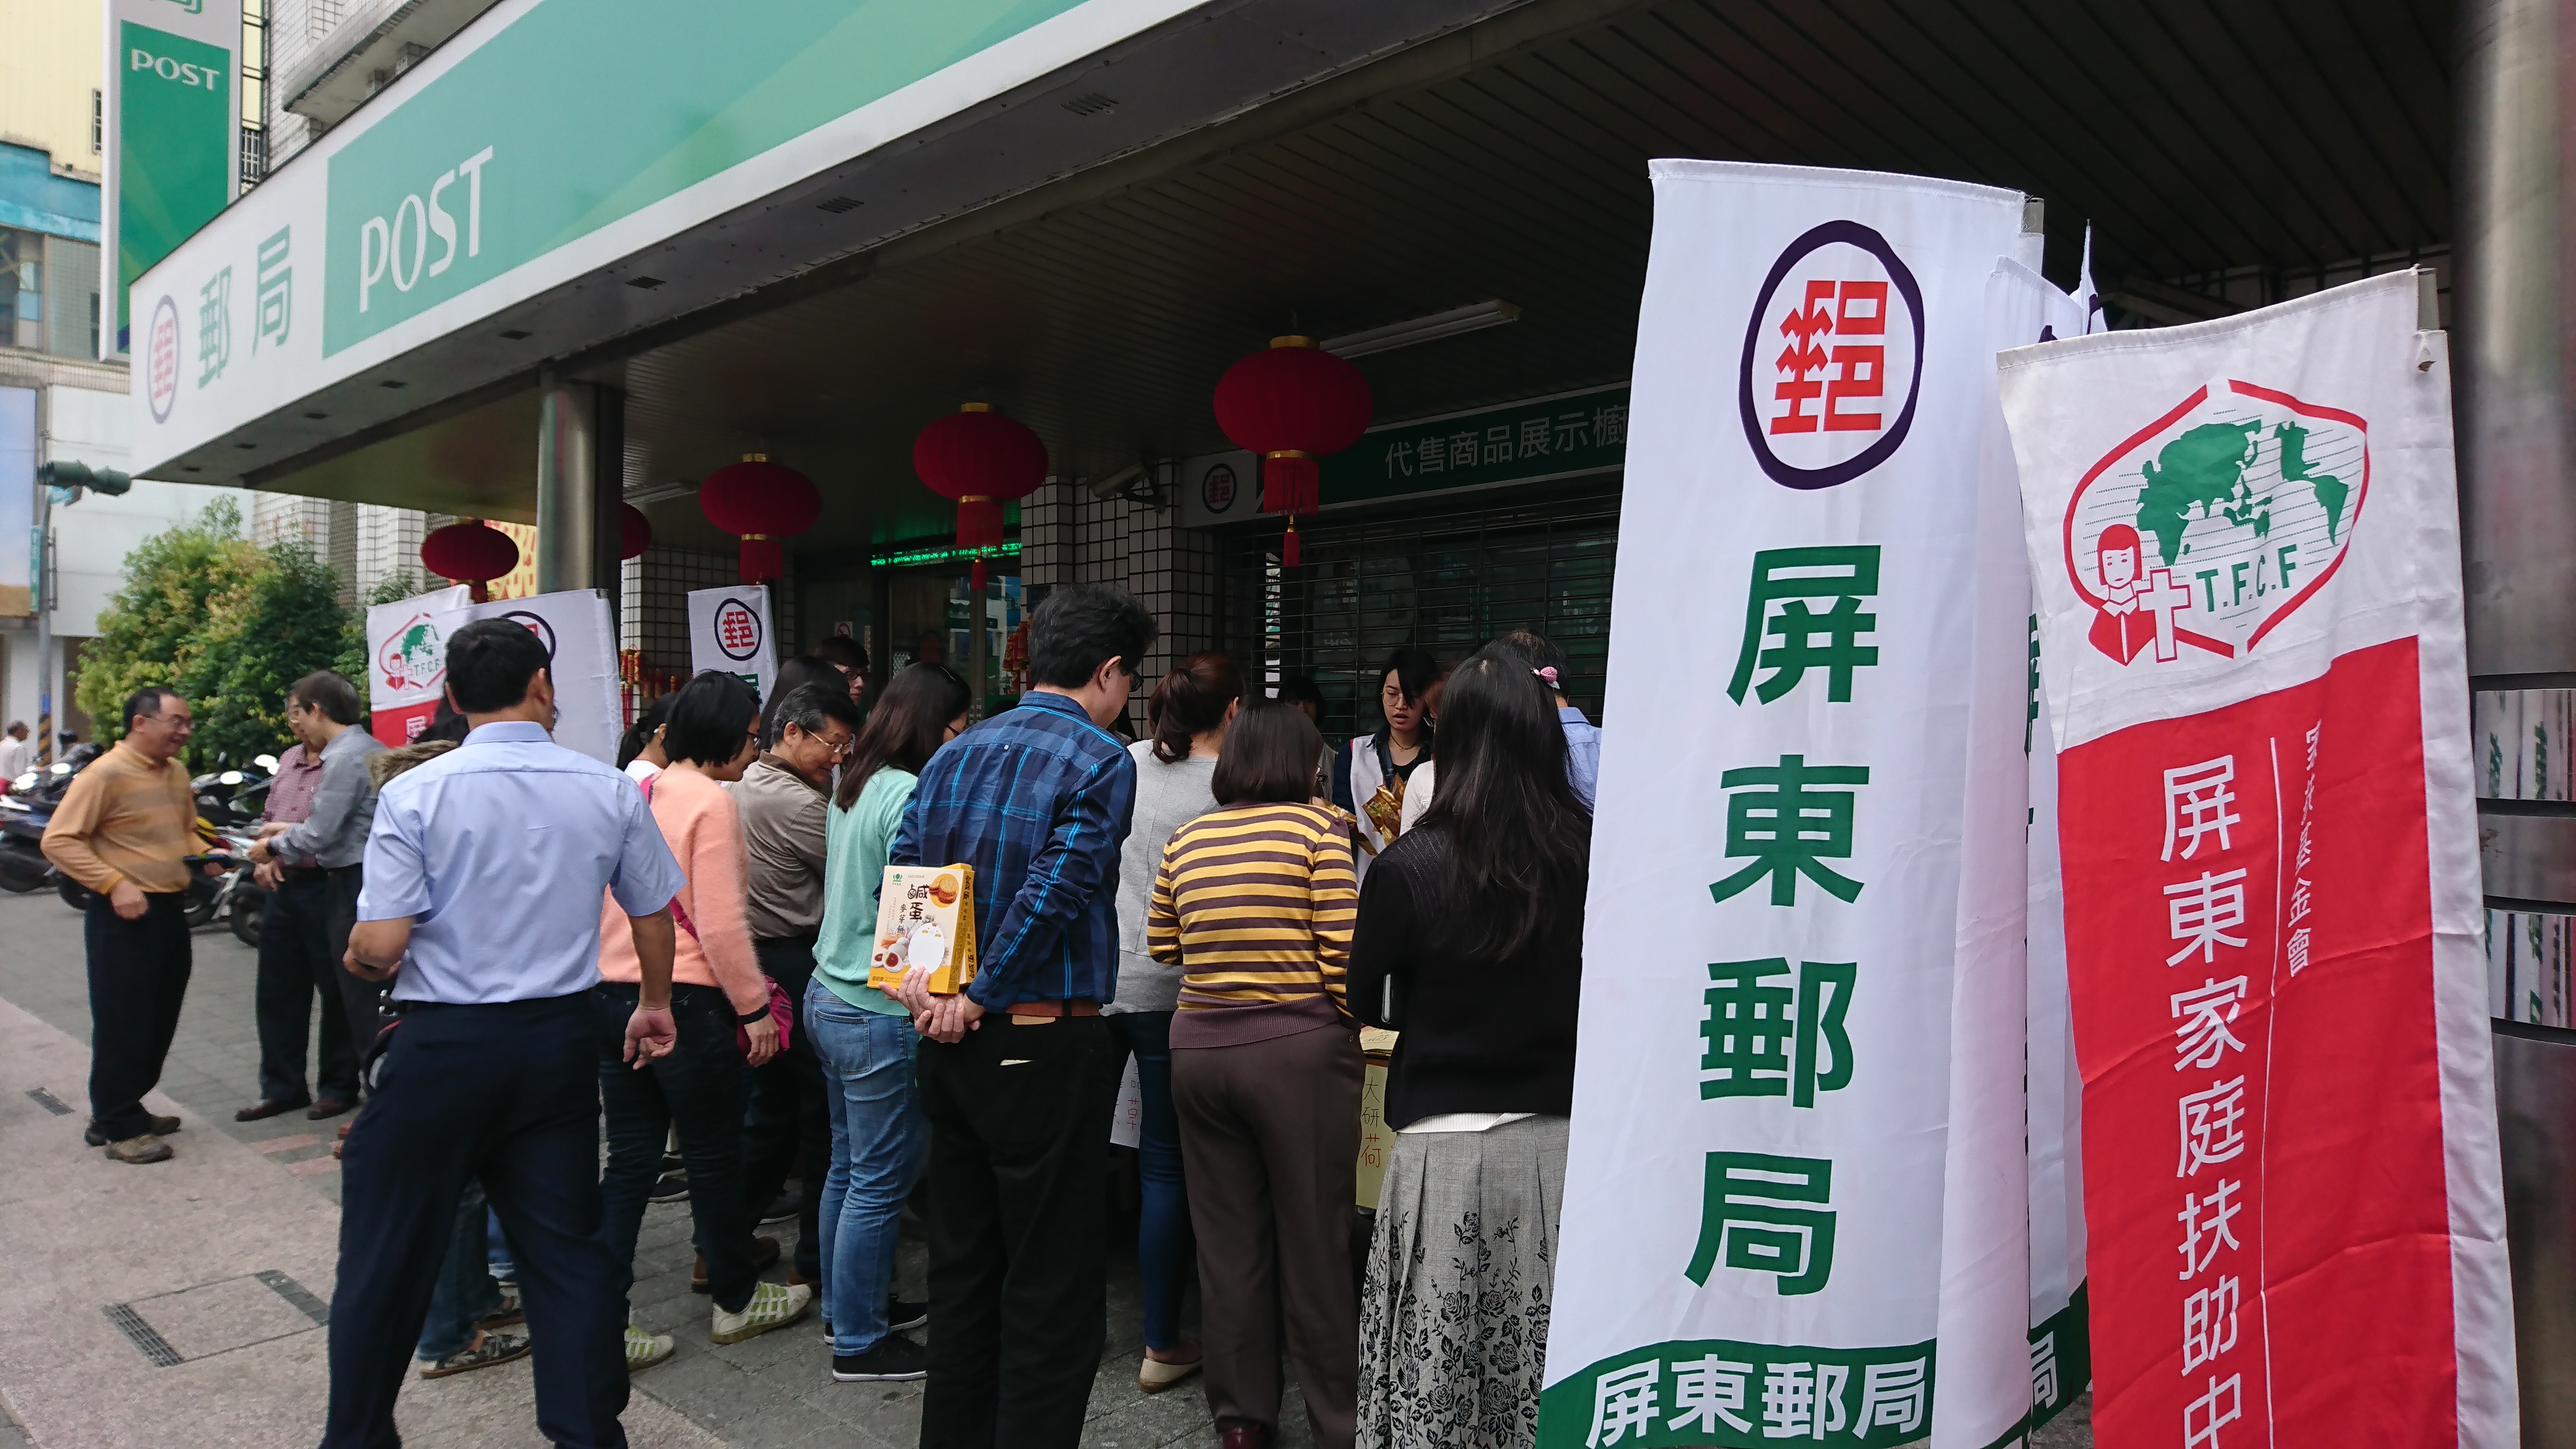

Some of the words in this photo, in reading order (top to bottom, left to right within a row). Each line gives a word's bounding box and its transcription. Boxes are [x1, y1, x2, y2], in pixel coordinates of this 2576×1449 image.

[131, 48, 220, 91] POST
[358, 145, 494, 313] POST
[197, 224, 291, 390] 郵局
[1385, 405, 1629, 480] 代售商品展示櫥
[2195, 544, 2297, 613] T.F.C.F
[897, 904, 907, 935] 麥芽餅
[907, 883, 929, 920] 鹹蛋
[1684, 545, 1881, 1296] 屏東郵局
[1360, 1076, 1381, 1168] 大研荷
[2160, 754, 2248, 1449] 屏東家庭扶助中
[1585, 1353, 1926, 1449] 屏東郵局
